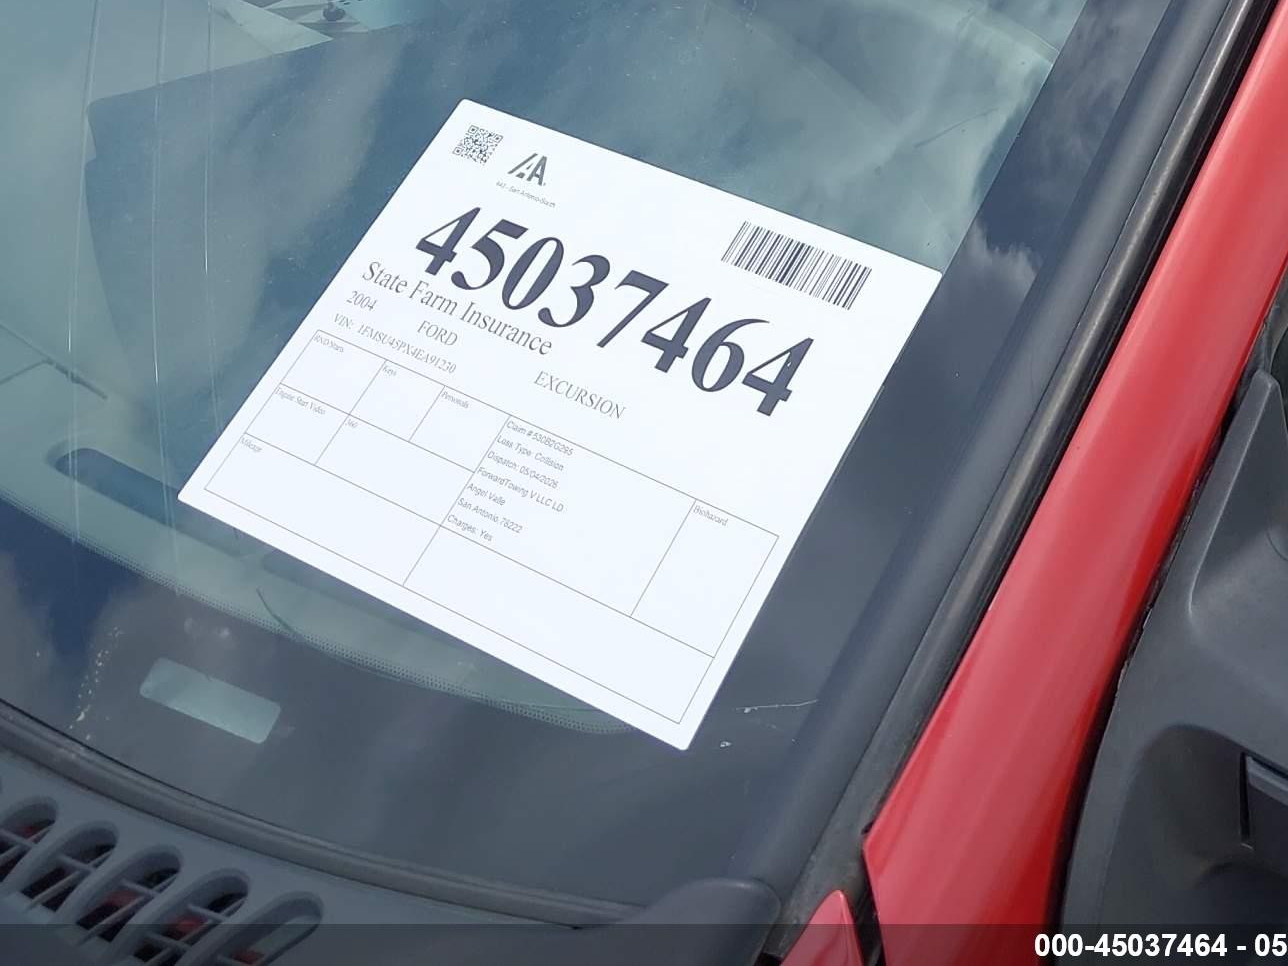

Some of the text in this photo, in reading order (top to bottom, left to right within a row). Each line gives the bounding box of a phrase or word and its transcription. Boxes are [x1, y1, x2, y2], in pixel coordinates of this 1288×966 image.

[334, 314, 354, 329] VIN:
[362, 262, 552, 355] State Farm Insurance
[416, 207, 815, 417] 45037464
[346, 291, 626, 418] 2004 FORD EXCURSION
[507, 421, 526, 434] Claim
[497, 435, 513, 448] Loss
[534, 452, 564, 471] Collision
[466, 483, 505, 506] Angel Valle
[477, 467, 529, 498] ForwardTowing
[536, 494, 552, 506] LLC
[552, 501, 564, 512] LD
[457, 497, 472, 510] San
[693, 505, 728, 526] Biohazard
[447, 514, 493, 541] Charges: Yes
